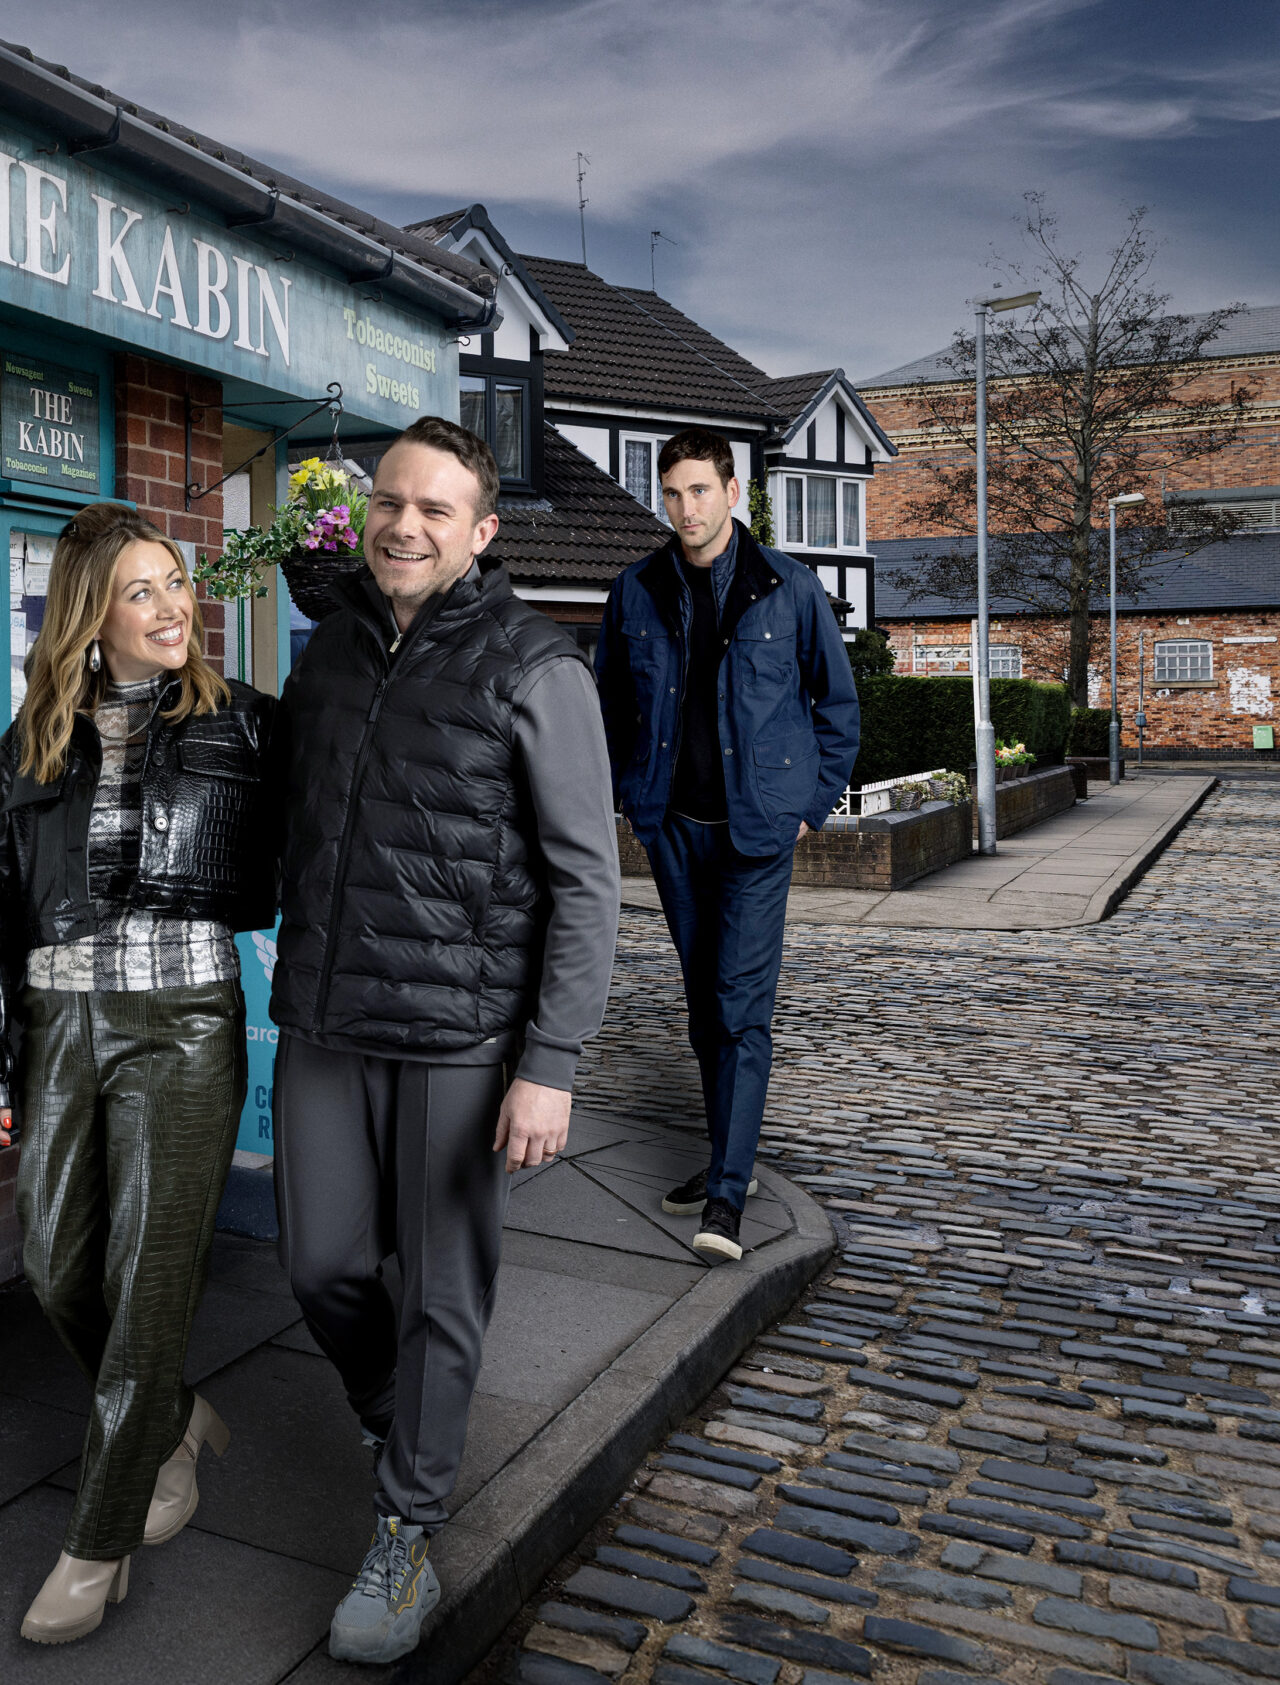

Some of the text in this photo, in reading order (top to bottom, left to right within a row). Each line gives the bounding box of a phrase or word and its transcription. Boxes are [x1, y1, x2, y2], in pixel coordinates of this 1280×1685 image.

[91, 193, 292, 366] KABIN
[344, 307, 436, 374] Tobacconist
[5, 361, 44, 381] Newsagent
[366, 363, 419, 409] Sweets
[30, 388, 73, 425] THE
[68, 382, 93, 398] Sweets
[18, 421, 84, 463] KABIN
[5, 457, 48, 475] Tobacconist
[61, 464, 97, 480] Magazines
